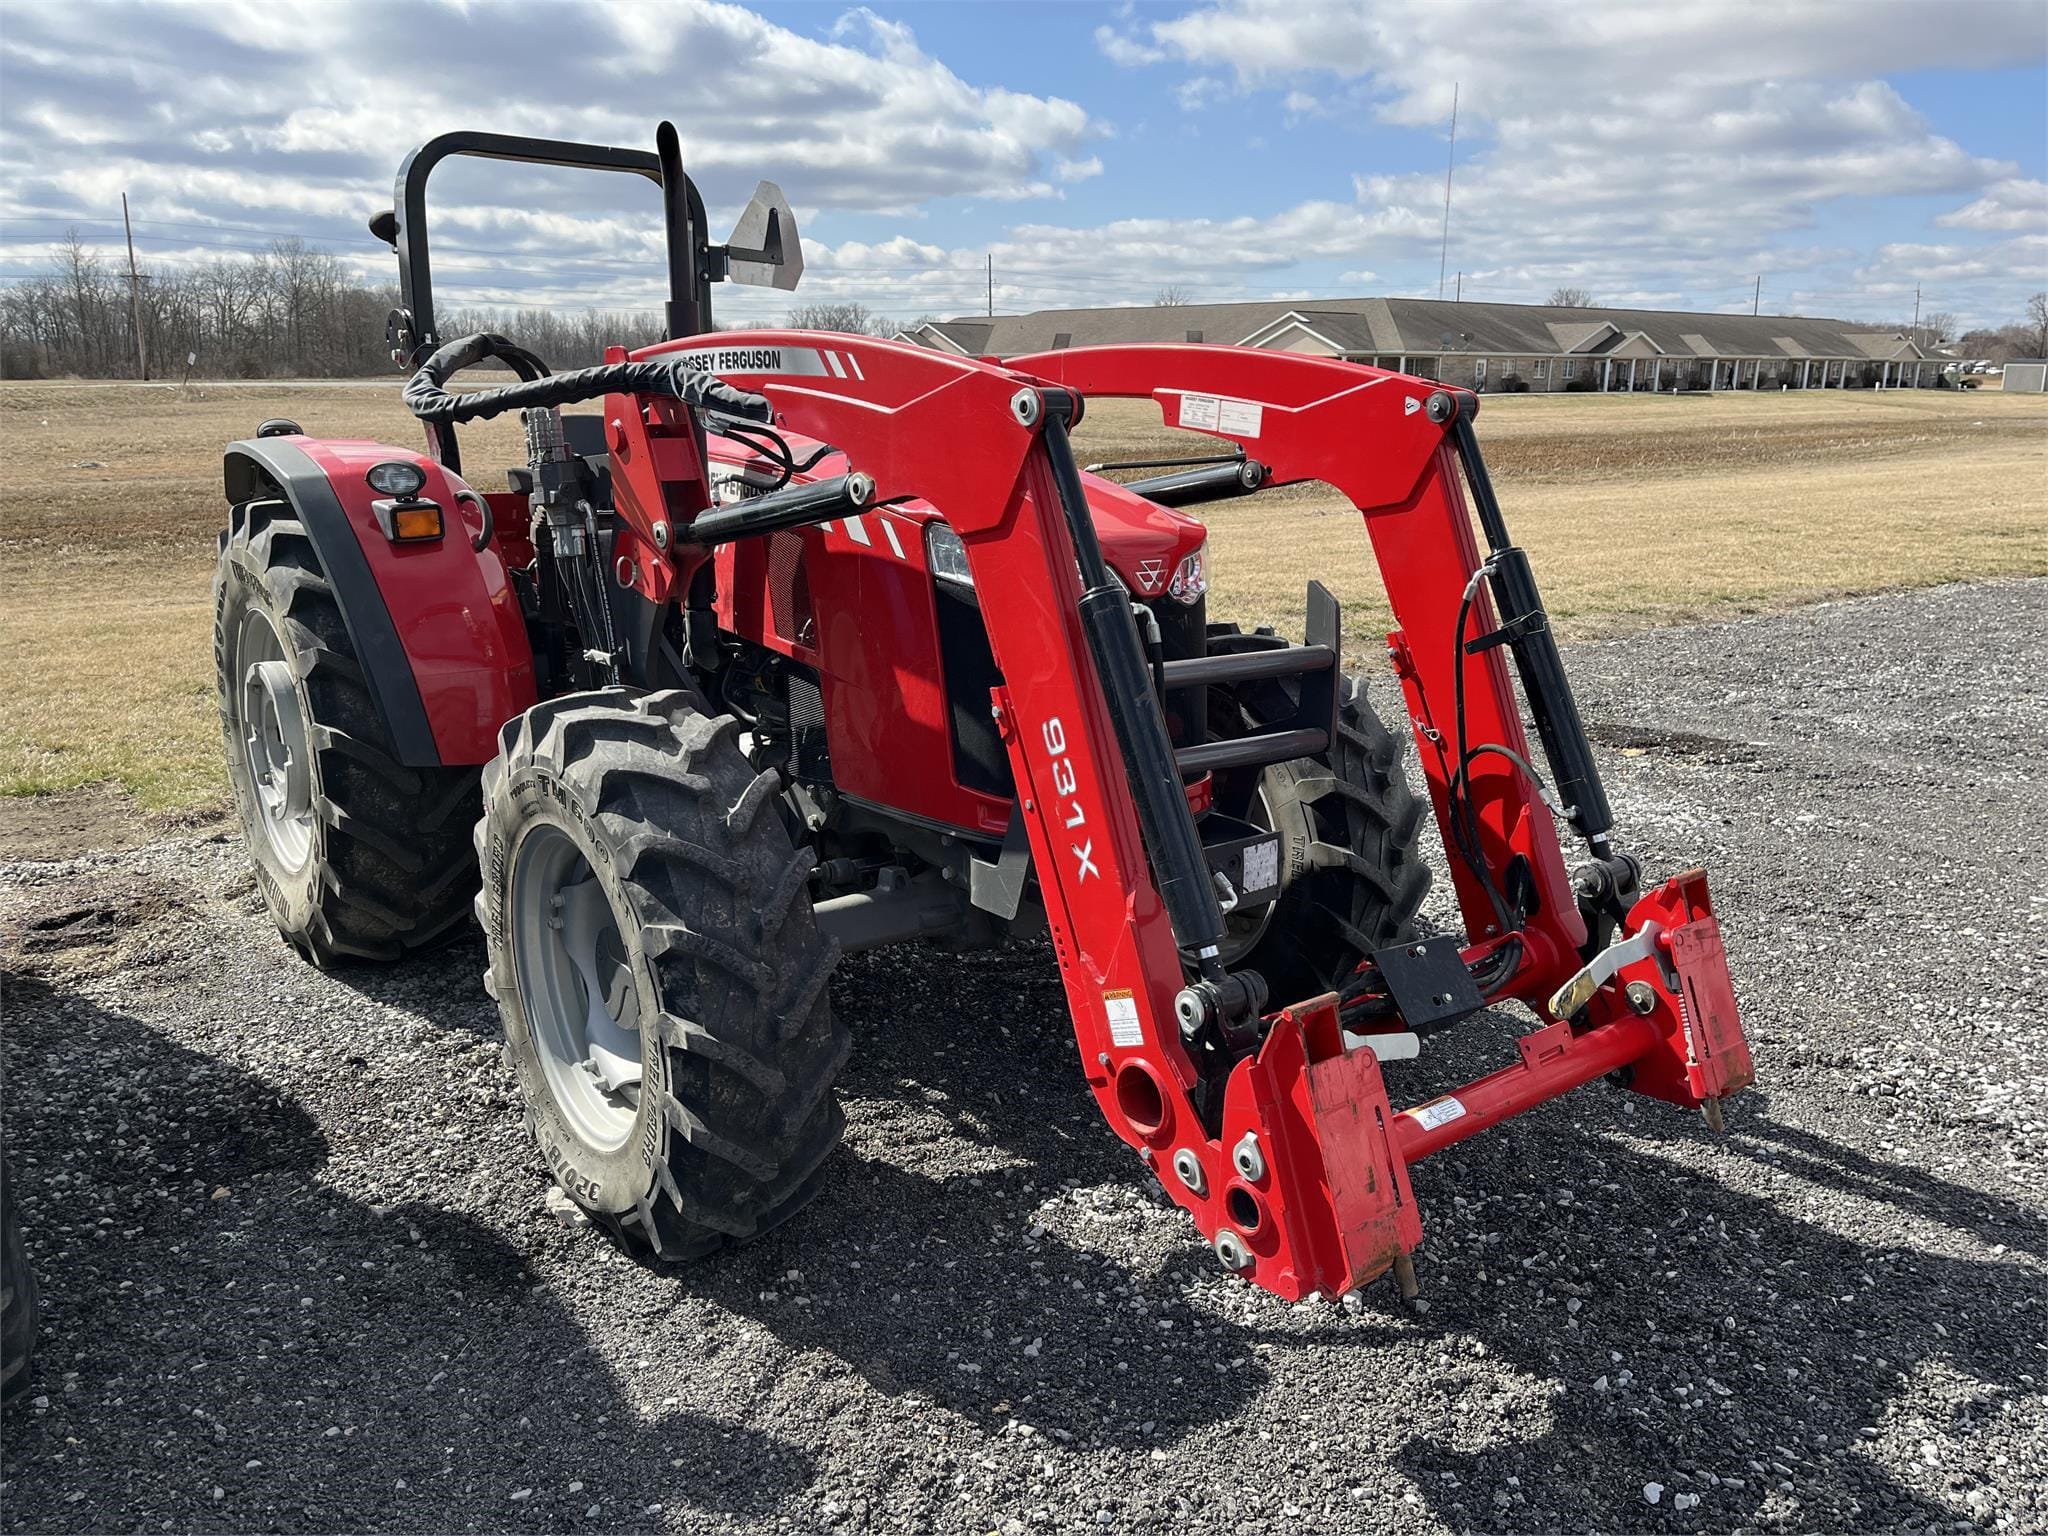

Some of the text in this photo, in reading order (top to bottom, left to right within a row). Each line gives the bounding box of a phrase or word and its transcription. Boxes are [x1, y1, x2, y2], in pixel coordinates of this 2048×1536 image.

[719, 350, 781, 370] FERGUSON
[1042, 717, 1101, 885] 931 X
